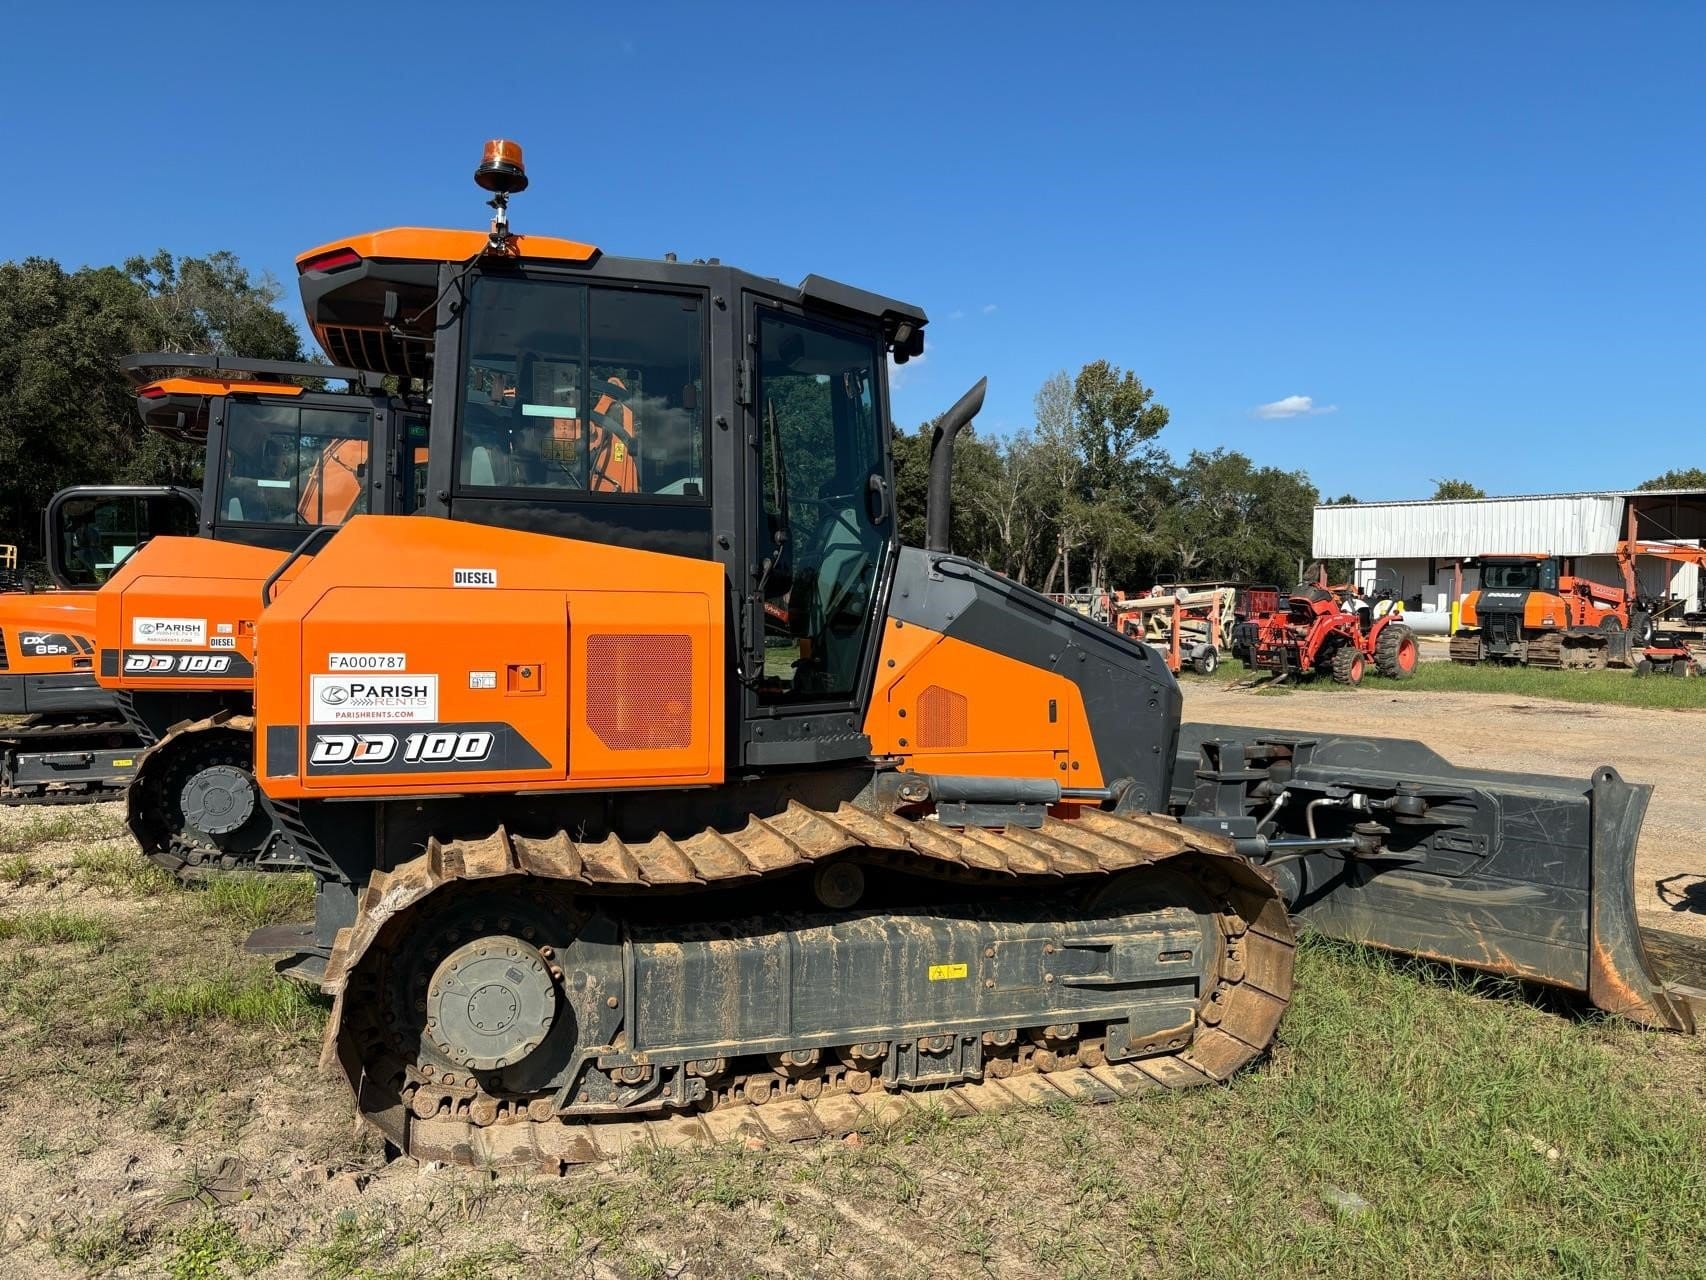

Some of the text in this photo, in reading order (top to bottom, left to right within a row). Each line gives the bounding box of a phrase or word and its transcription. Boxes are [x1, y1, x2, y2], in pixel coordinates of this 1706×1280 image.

[455, 571, 495, 584] DIESEL
[156, 623, 201, 632] PARISH
[23, 634, 52, 645] DX
[210, 638, 234, 647] DIESEL
[36, 645, 68, 654] 85R
[124, 655, 231, 673] DD 100
[330, 656, 404, 668] FA000787
[350, 683, 427, 698] PARISH
[374, 697, 428, 706] RENTS
[335, 711, 415, 719] PARISHRENTS.COM
[310, 732, 495, 766] DD 100
